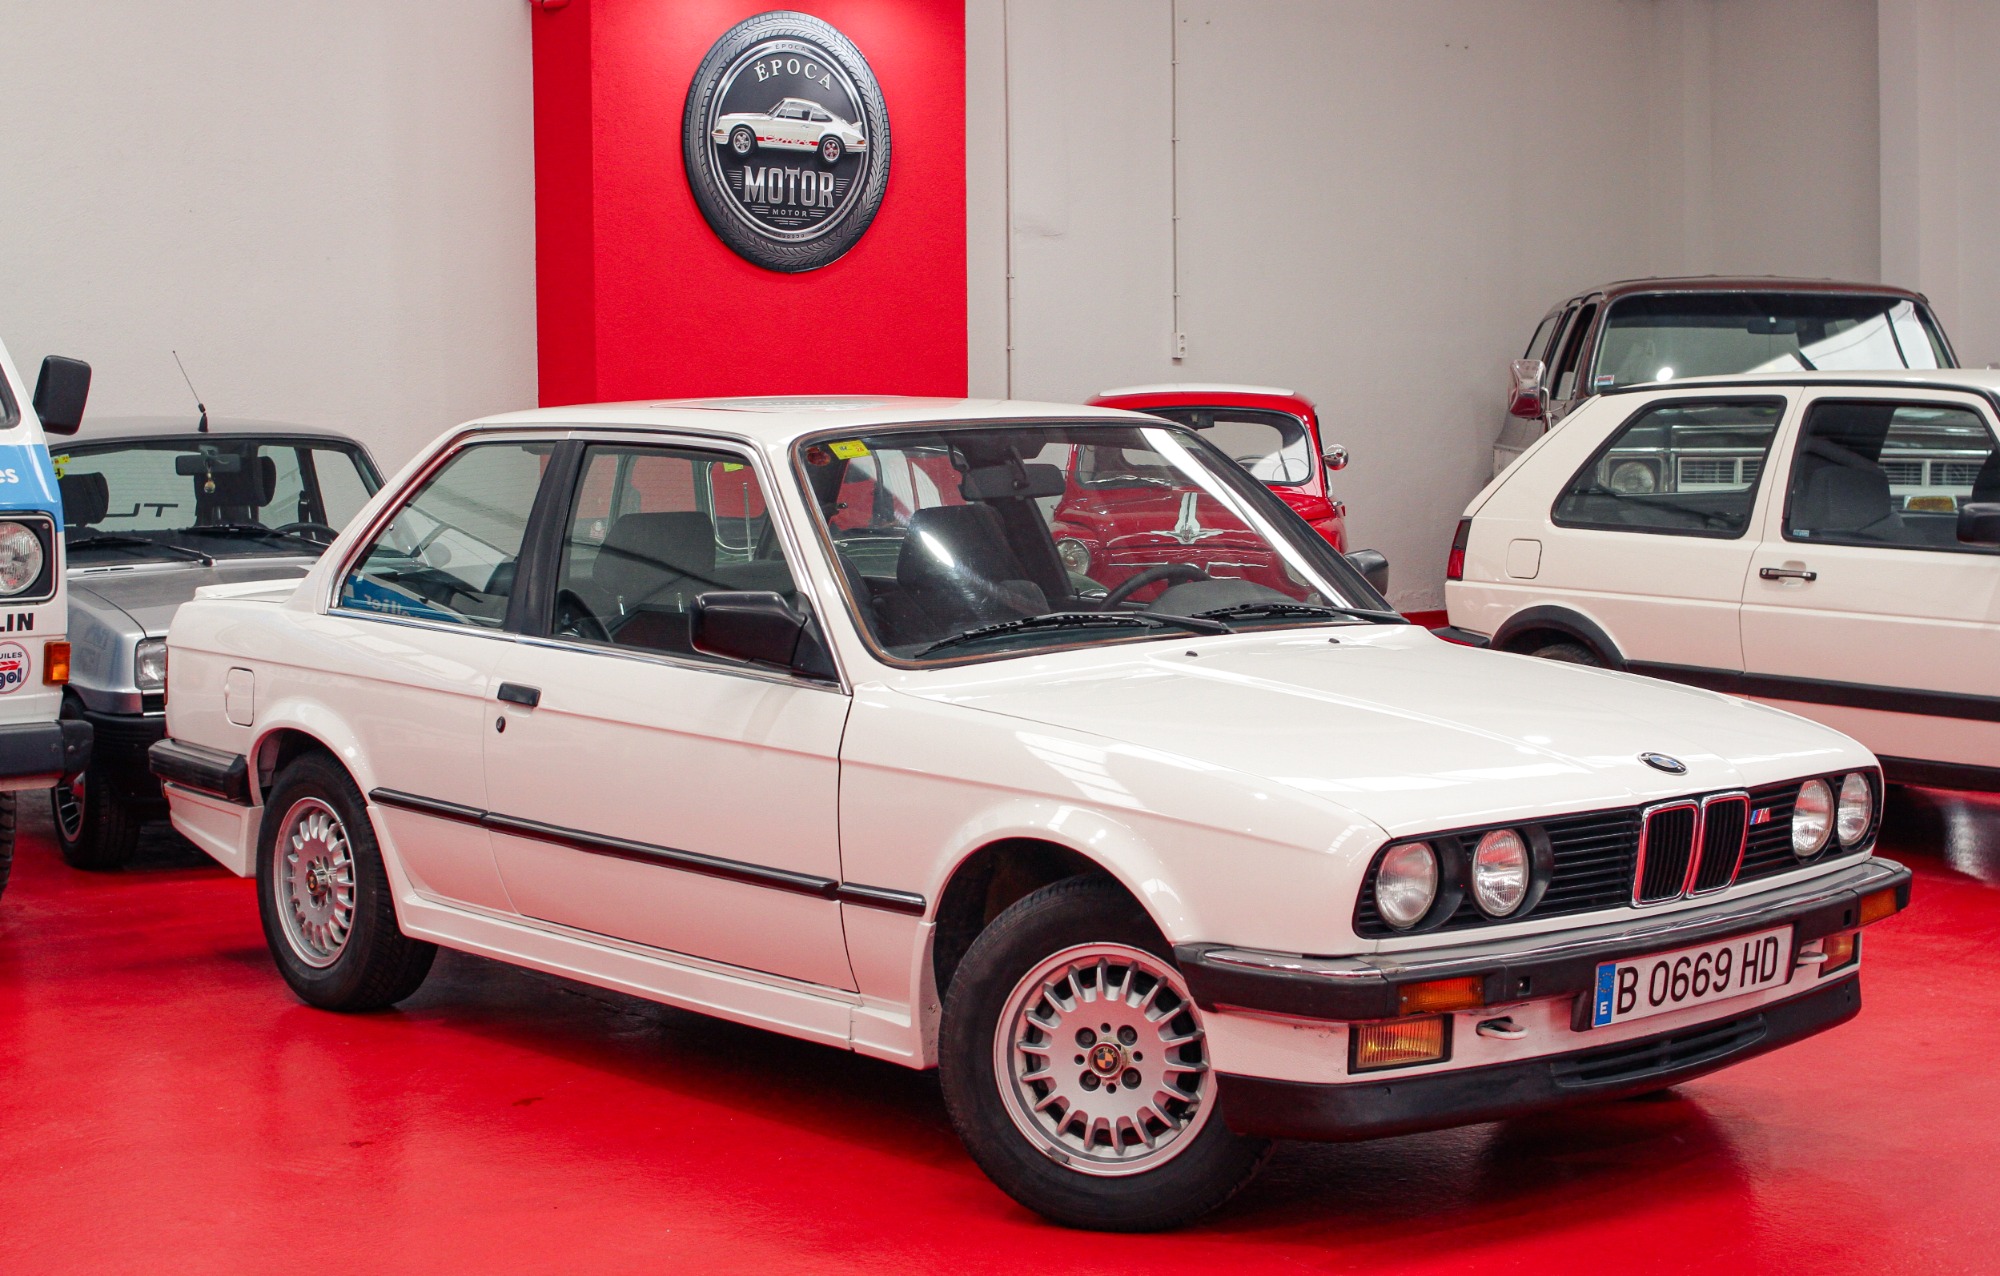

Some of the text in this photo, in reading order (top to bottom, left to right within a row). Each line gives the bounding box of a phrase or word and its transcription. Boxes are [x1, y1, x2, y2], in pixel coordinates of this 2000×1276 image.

[754, 58, 831, 91] ÉPOCA
[743, 165, 835, 208] MOTOR
[772, 208, 808, 217] MOTOR
[1616, 936, 1780, 1015] B 0669 HD
[1599, 1001, 1609, 1016] E
